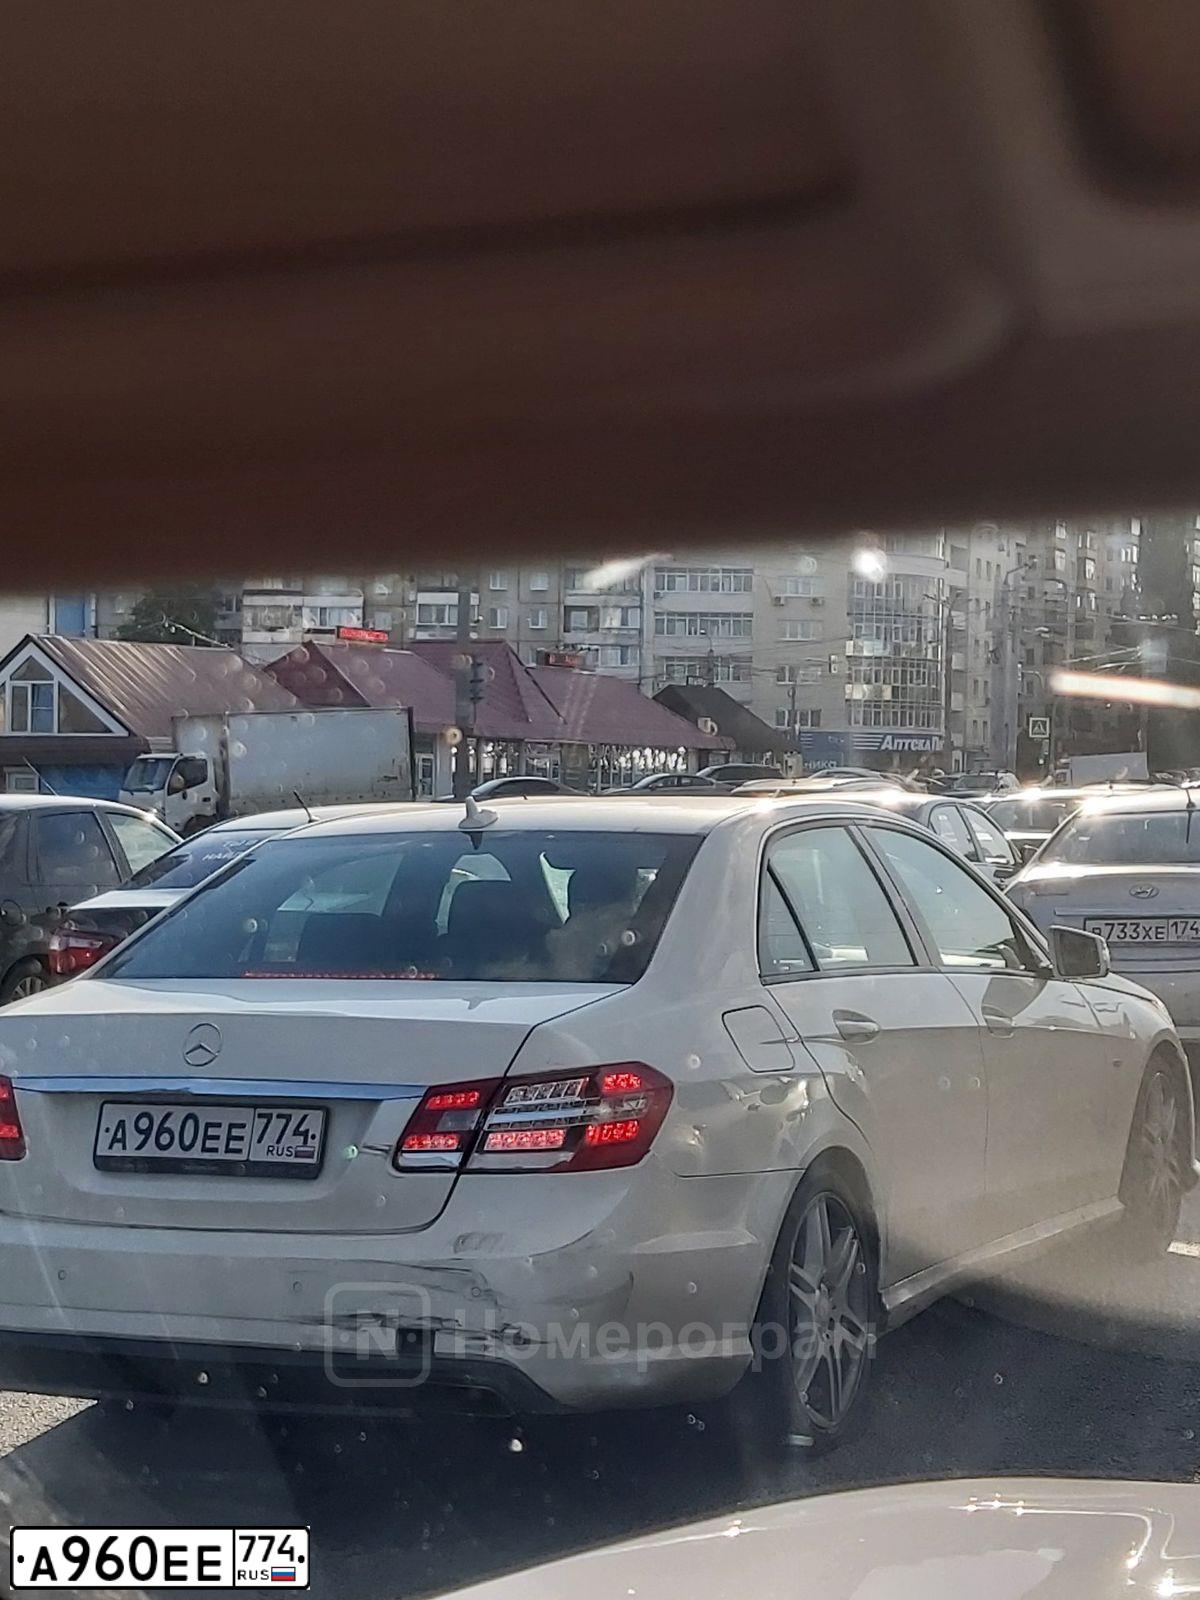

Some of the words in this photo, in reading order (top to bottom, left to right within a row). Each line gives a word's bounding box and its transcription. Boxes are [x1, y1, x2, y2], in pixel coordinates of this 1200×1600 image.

[1171, 921, 1200, 935] 174
[108, 1111, 247, 1154] А960ЕЕ
[256, 1112, 310, 1146] 774
[266, 1145, 294, 1158] RUS
